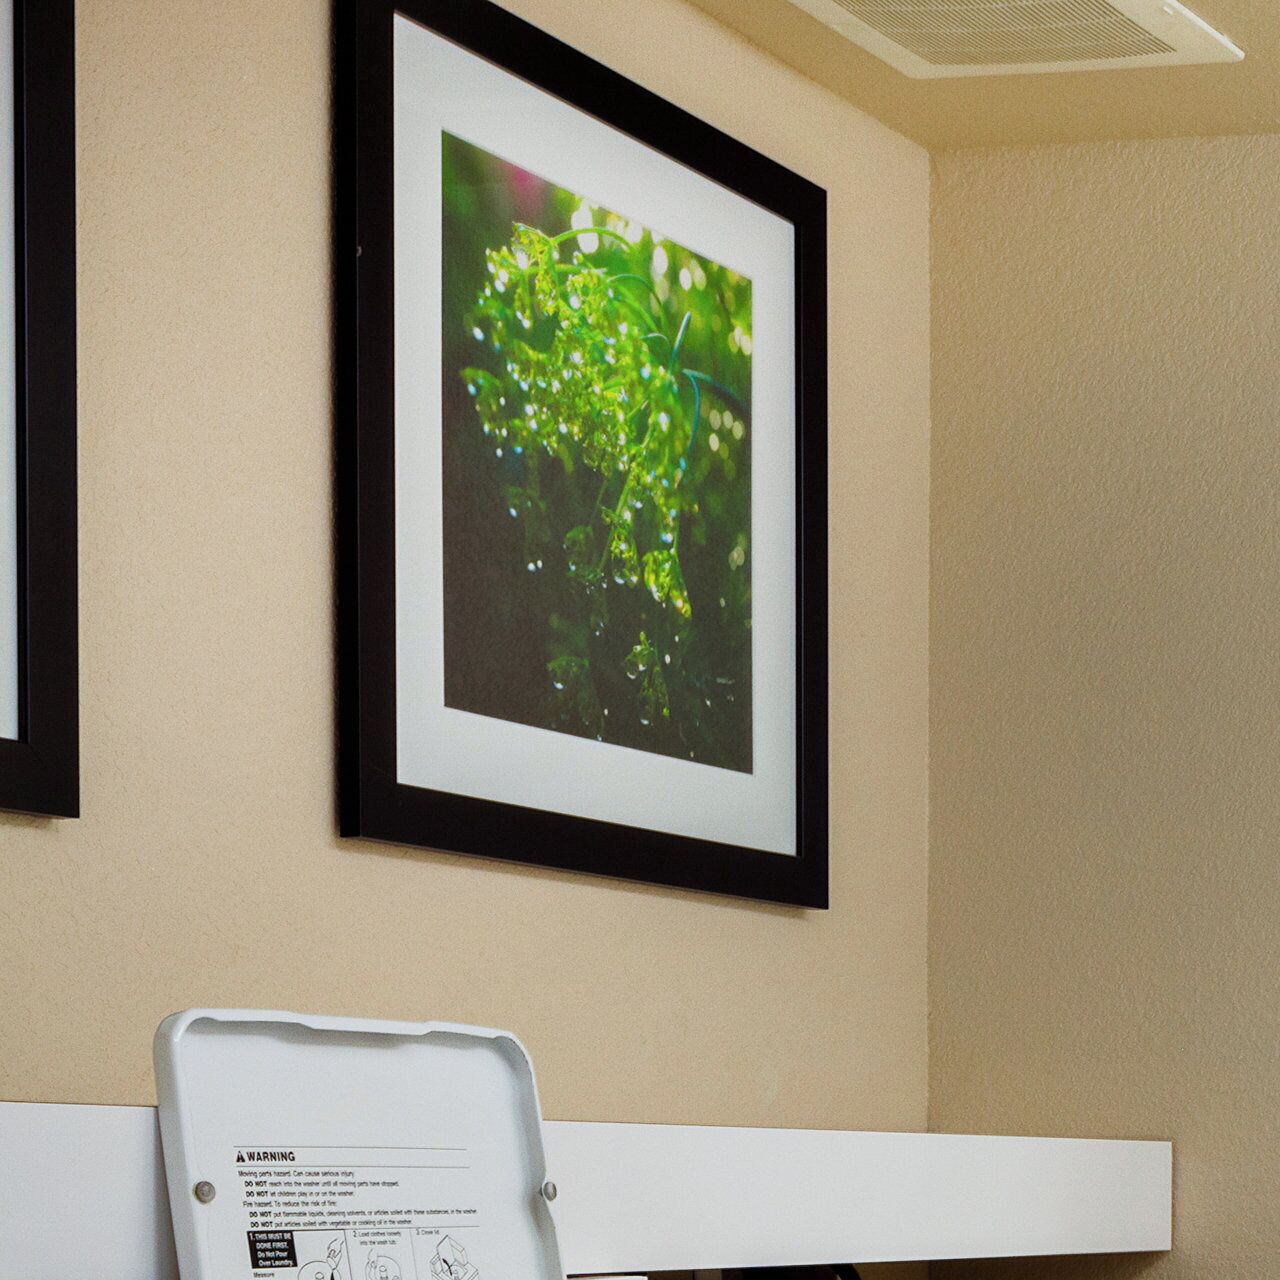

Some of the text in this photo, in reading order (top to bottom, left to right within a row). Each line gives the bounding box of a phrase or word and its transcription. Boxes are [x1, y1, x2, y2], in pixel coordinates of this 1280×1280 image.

[246, 1151, 296, 1162] WARNING
[238, 1170, 257, 1179] Moving
[244, 1180, 254, 1188] DO
[255, 1180, 267, 1188] NOT
[338, 1181, 356, 1189] moving
[245, 1190, 255, 1198] DO
[256, 1190, 268, 1198] NOT
[297, 1191, 308, 1199] play
[249, 1210, 258, 1218] DO
[259, 1210, 272, 1218] NOT
[250, 1220, 260, 1229] DO
[260, 1220, 273, 1228] NOT
[283, 1232, 292, 1240] BE
[256, 1241, 272, 1249] DONE
[275, 1250, 288, 1258] Pour
